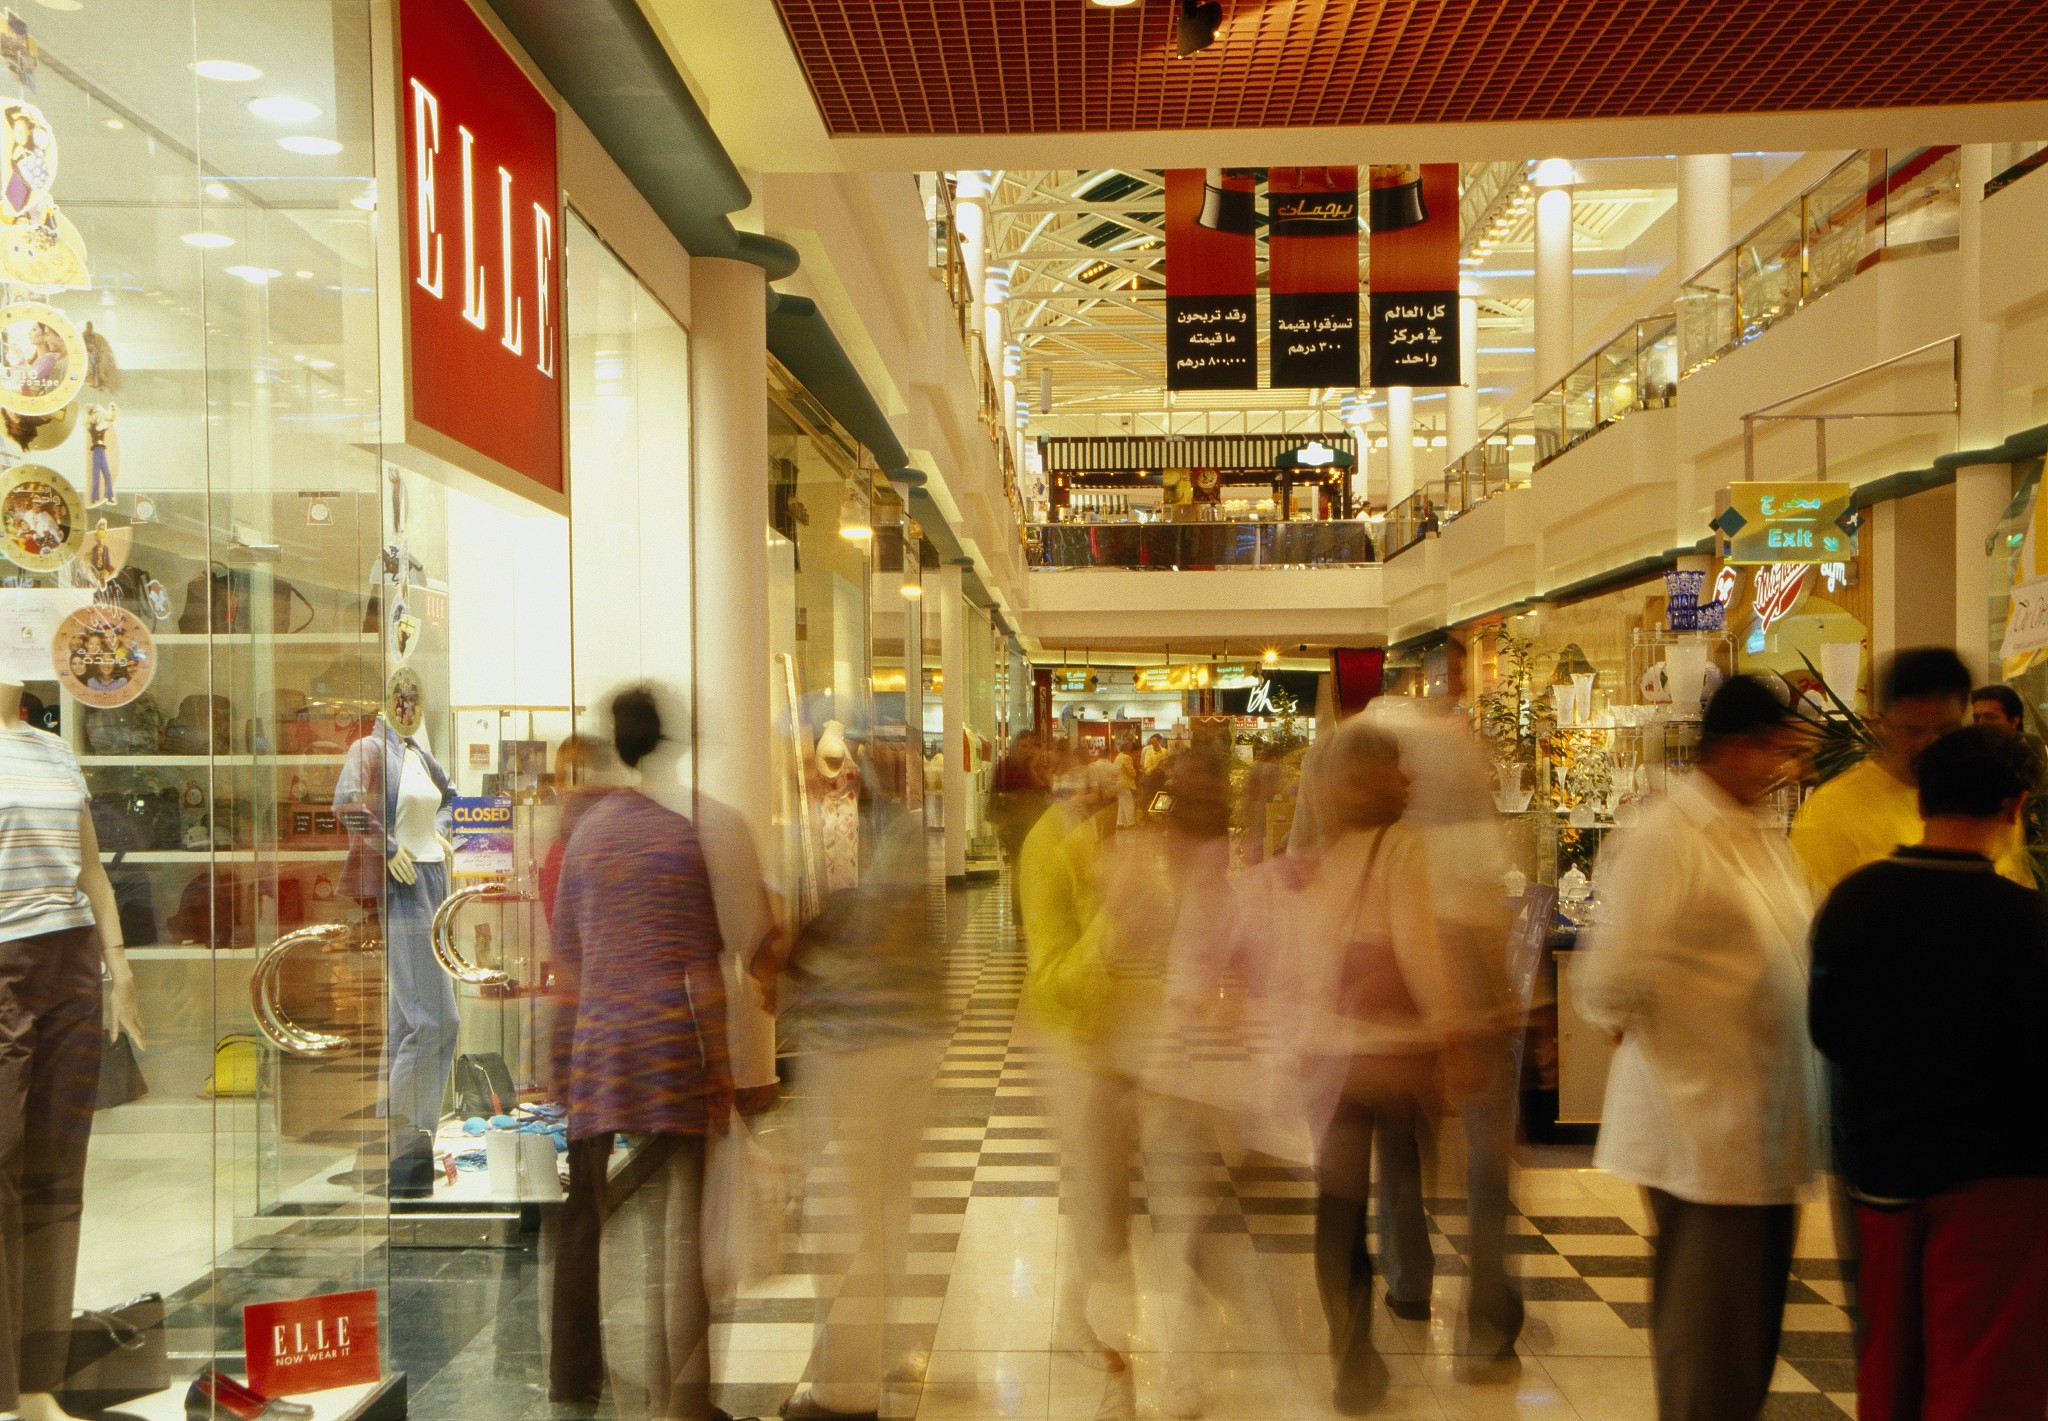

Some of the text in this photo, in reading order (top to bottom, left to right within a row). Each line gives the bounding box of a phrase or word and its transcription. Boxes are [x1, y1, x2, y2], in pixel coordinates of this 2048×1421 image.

[1277, 199, 1354, 219] برجمان
[411, 77, 554, 379] ELLE
[1177, 308, 1247, 324] وقد تربحون
[1384, 304, 1446, 322] كل العالم
[1278, 319, 1311, 333] بقيمة
[1189, 331, 1236, 346] ما قيمته
[1388, 326, 1443, 345] في مركز
[1288, 343, 1316, 356] درهم
[1176, 357, 1205, 370] درهم
[1760, 493, 1821, 515] مخرج
[1768, 528, 1813, 547] Exit
[453, 807, 511, 822] CLOSED
[273, 1316, 351, 1356] ELLE
[276, 1347, 350, 1367] NOW WEAR IT
